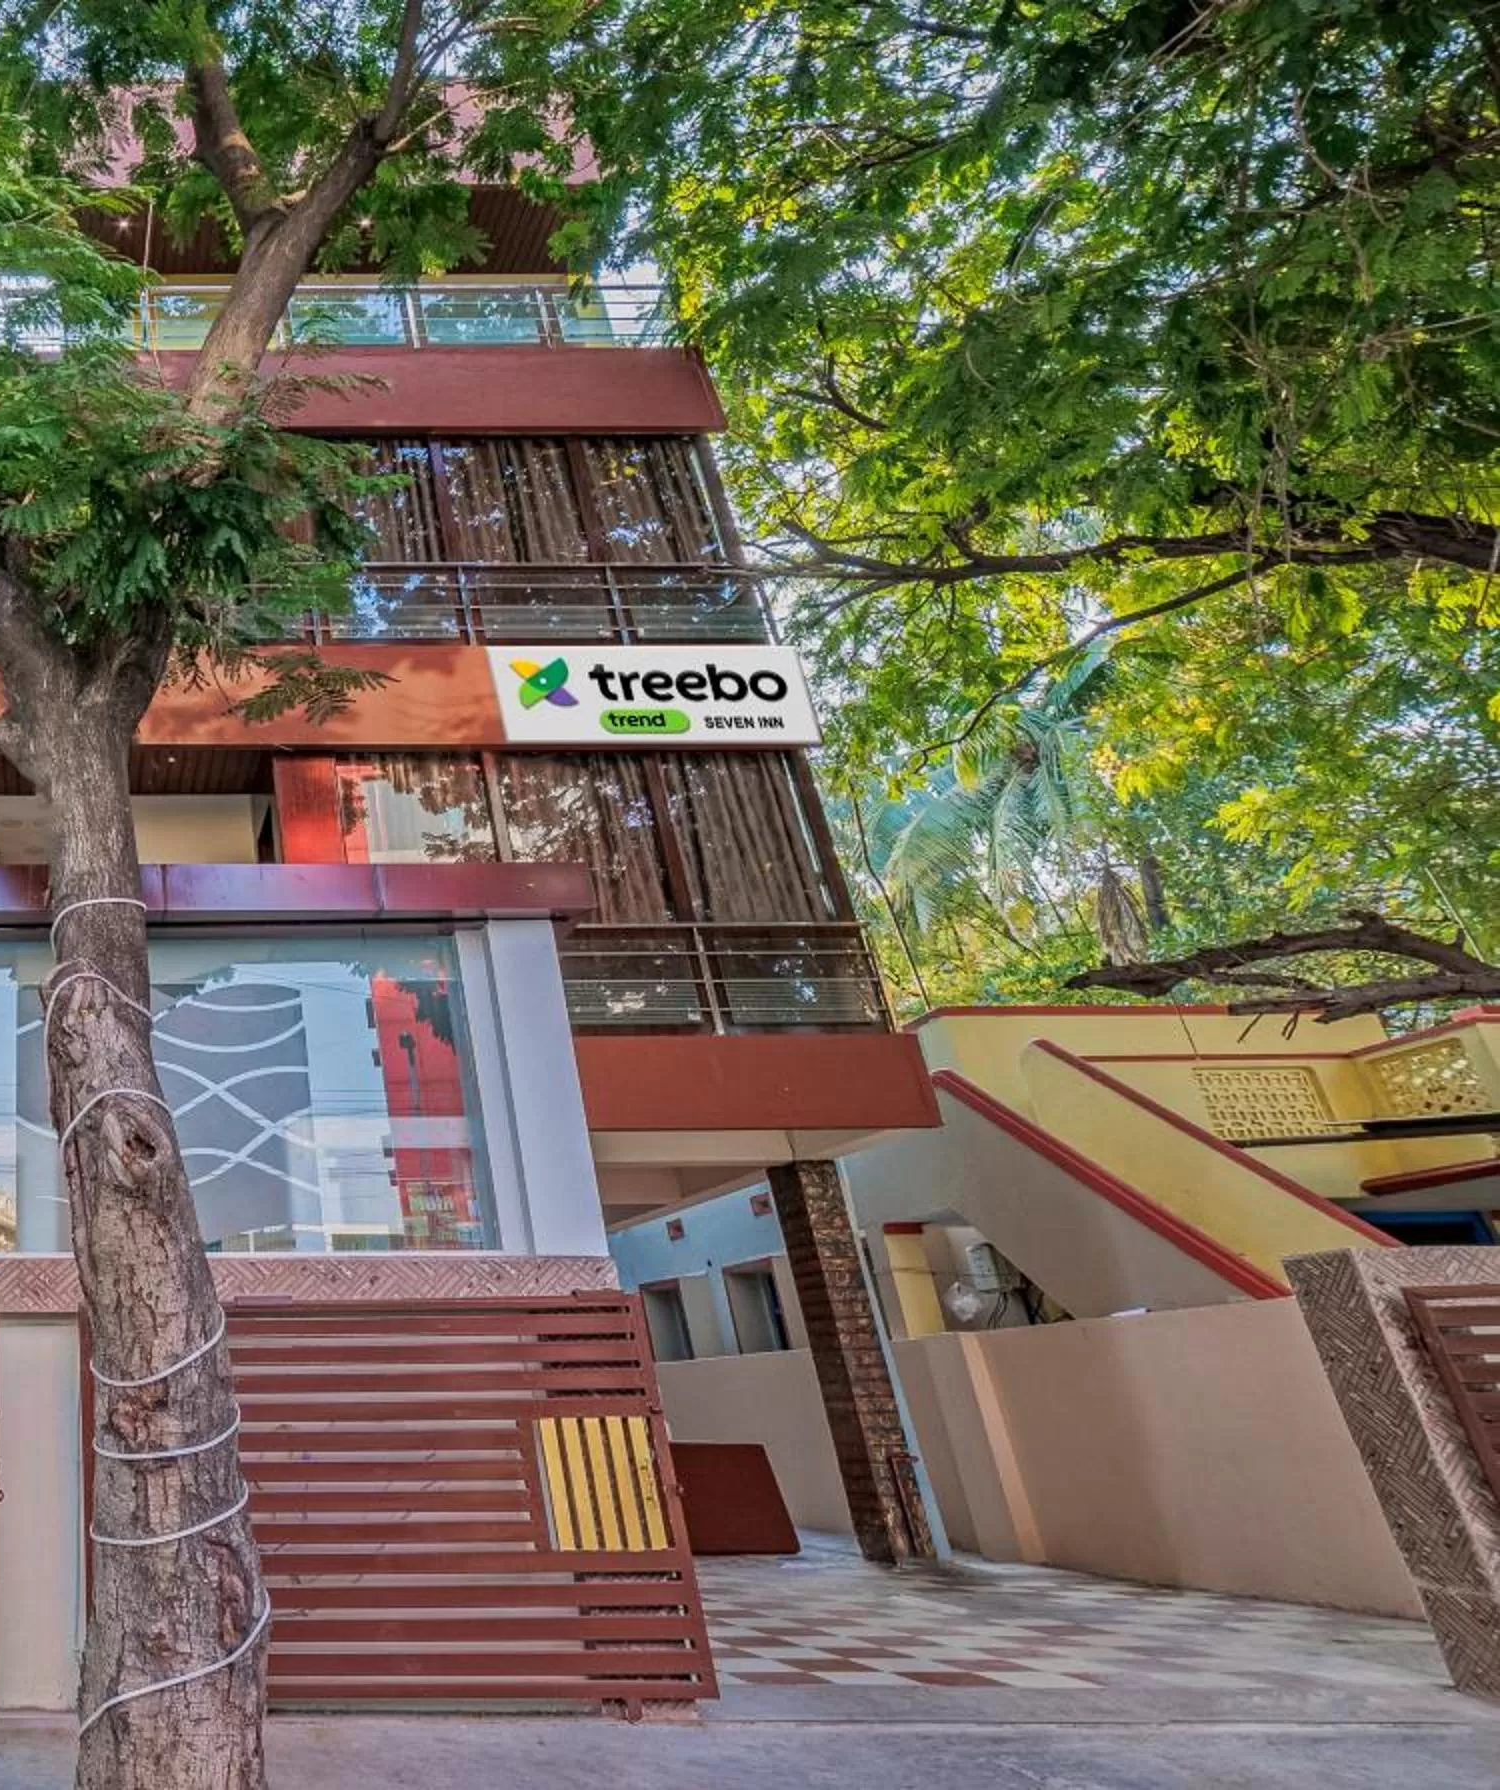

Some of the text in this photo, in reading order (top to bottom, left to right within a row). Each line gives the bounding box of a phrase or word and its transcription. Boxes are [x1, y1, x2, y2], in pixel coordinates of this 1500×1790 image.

[588, 664, 788, 702] treebo
[608, 713, 667, 728] trend
[704, 716, 785, 729] SEVEN INN
